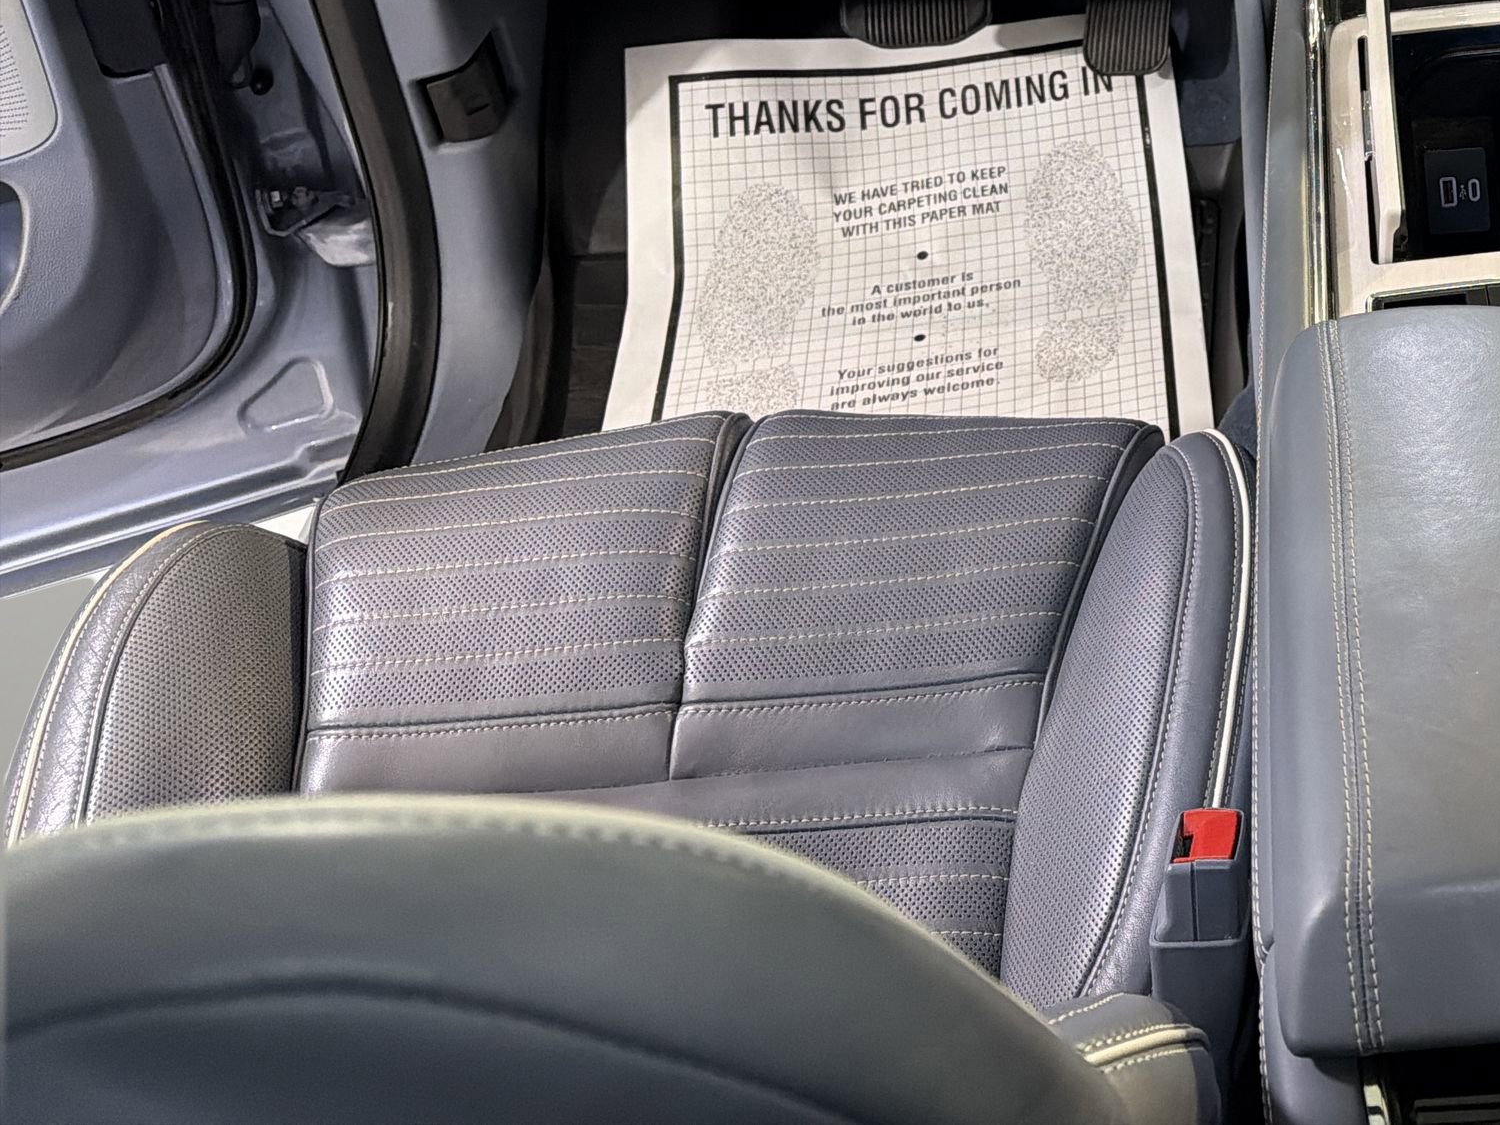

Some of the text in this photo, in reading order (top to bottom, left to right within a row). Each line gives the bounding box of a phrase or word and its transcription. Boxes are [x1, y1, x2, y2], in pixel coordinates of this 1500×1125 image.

[704, 65, 1114, 139] THANKS FOR COMING IN
[832, 182, 1009, 223] YOUR CARPETING CLEAN
[833, 165, 1007, 206] WE HAVE TRIED TO KEEP
[841, 200, 1002, 238] WITH THIS PAPER MAT
[821, 277, 1022, 318] the most important person
[871, 271, 974, 296] A customer is
[852, 315, 866, 326] in
[872, 312, 895, 324] the
[900, 303, 943, 320] world
[947, 301, 962, 313] to
[829, 360, 1004, 397] improving our service
[837, 347, 1000, 381] Your suggestions for
[830, 377, 1001, 411] are always welcome.
